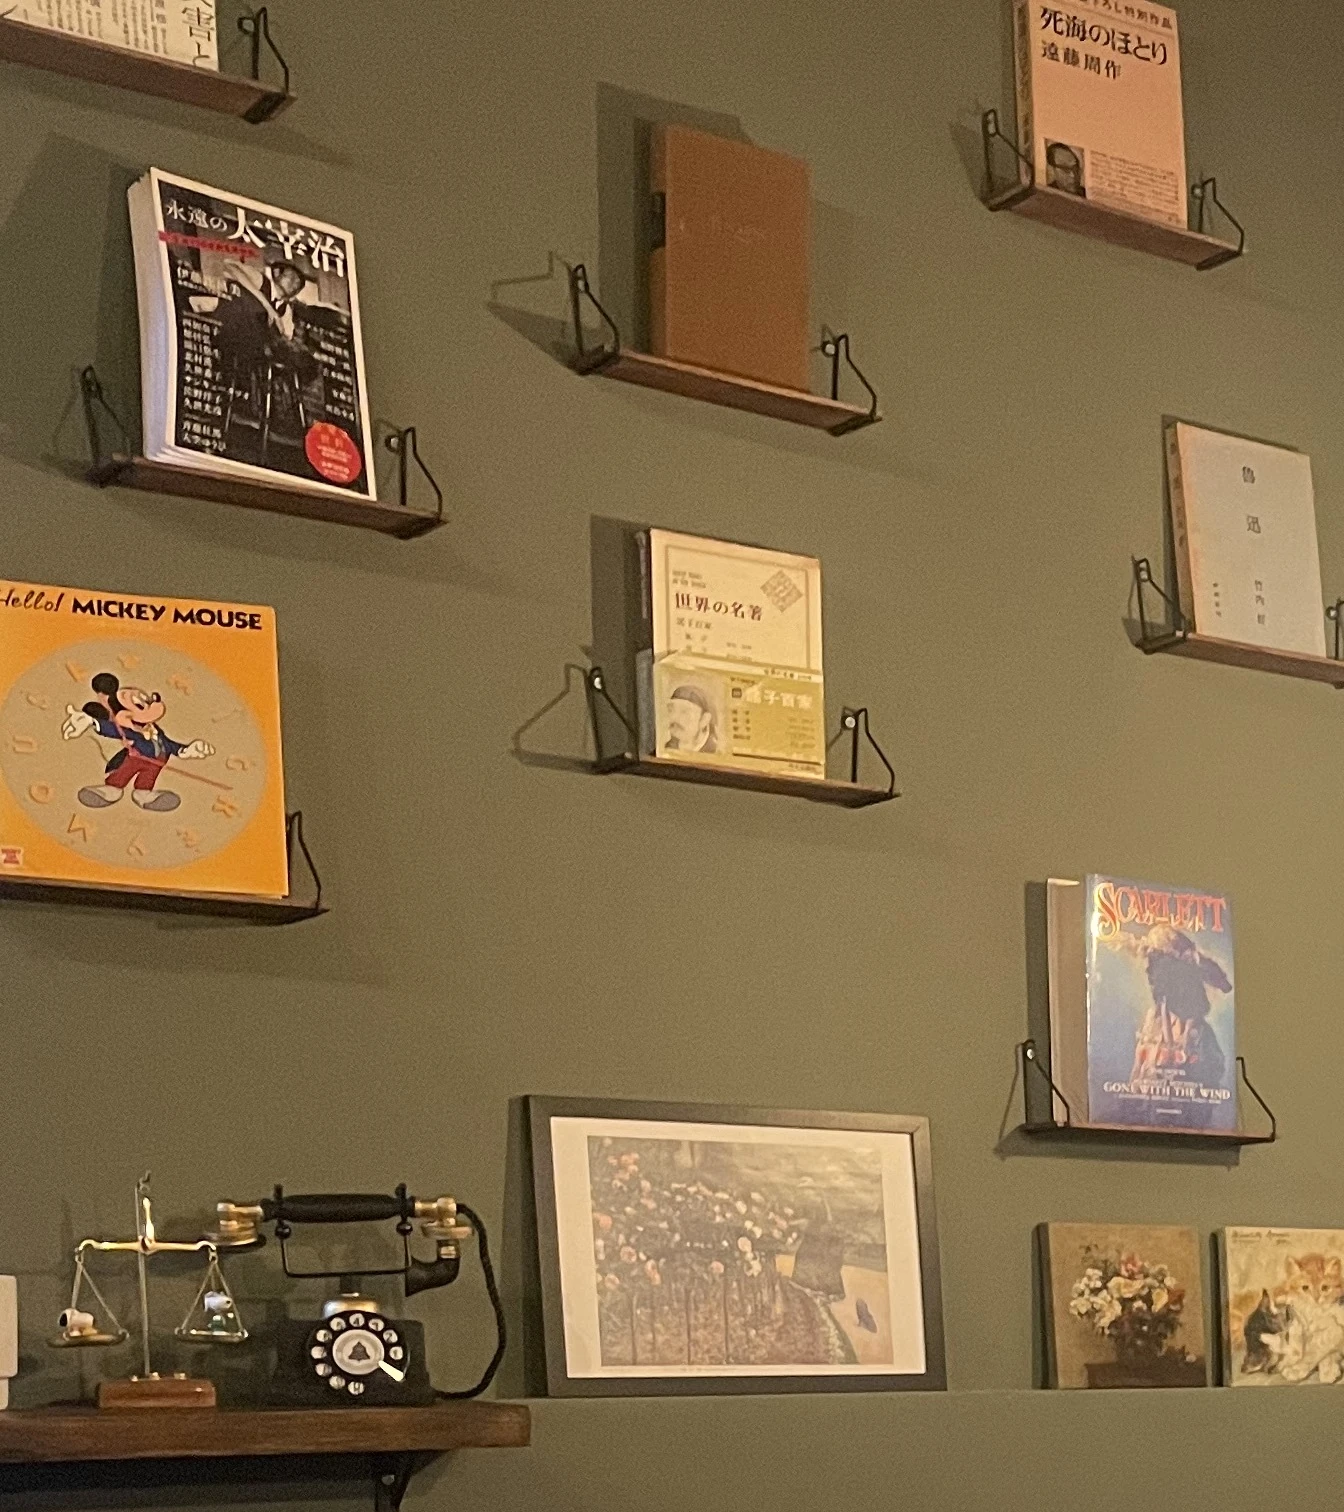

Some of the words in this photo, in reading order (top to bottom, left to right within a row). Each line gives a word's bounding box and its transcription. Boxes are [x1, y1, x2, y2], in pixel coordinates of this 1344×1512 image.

[1041, 7, 1168, 66] 死海のほとり
[1041, 41, 1121, 79] 遠藤周作
[72, 597, 165, 622] MICKEY
[173, 607, 262, 630] MOUSE
[675, 593, 763, 621] 世界の名著
[1092, 882, 1227, 939] SCARLETT
[1103, 1081, 1139, 1094] GONE
[1140, 1083, 1170, 1096] WITH
[1173, 1085, 1196, 1097] THE
[1199, 1088, 1231, 1100] WIND
